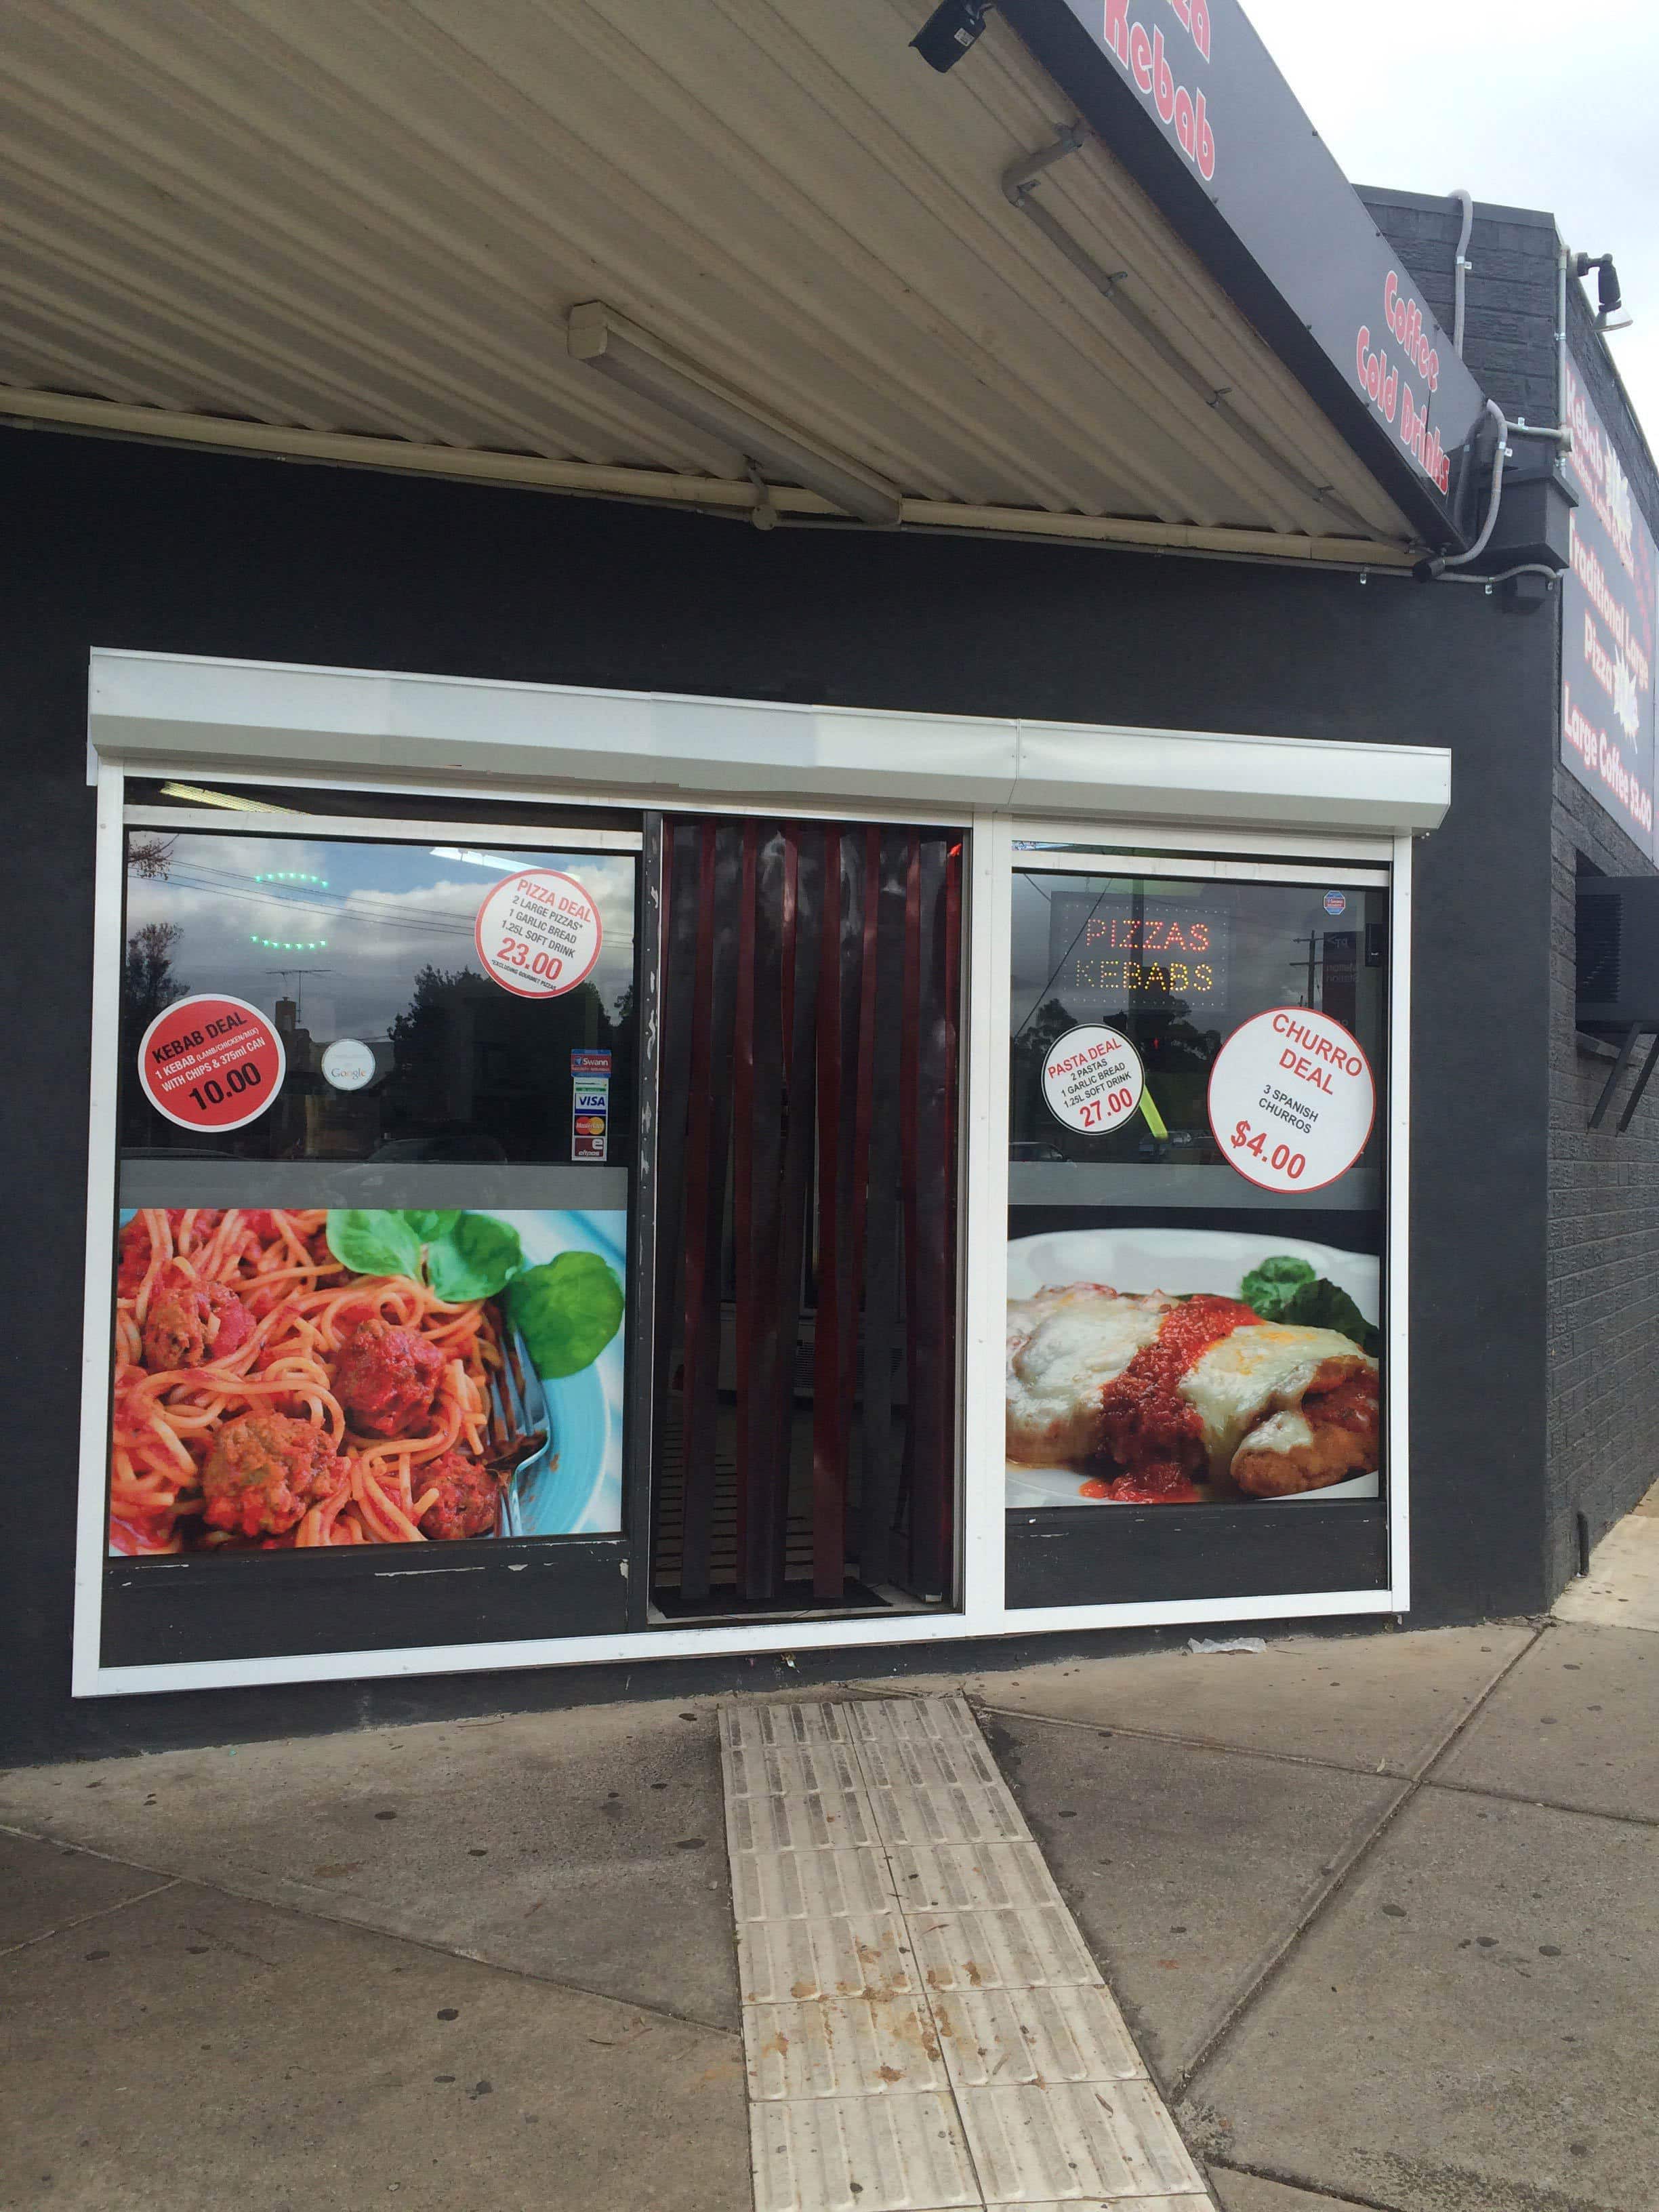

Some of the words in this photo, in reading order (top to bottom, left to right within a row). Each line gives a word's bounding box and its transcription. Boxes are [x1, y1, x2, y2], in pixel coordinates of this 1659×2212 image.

[1104, 0, 1215, 181] Kebab
[1385, 270, 1439, 392] Coffee
[1357, 325, 1398, 423] Cold
[1400, 382, 1450, 495] Drinks
[1564, 681, 1598, 769] Large
[1599, 729, 1629, 808] Coffee
[512, 895, 520, 905] 2
[520, 898, 549, 917] LARGE
[517, 879, 555, 906] PIZZA
[558, 897, 592, 922] DEAL
[501, 920, 523, 937] 1.25L
[525, 930, 548, 946] SOFT
[548, 939, 575, 958] DRINK
[510, 909, 514, 917] 1
[516, 911, 548, 931] GARLIC
[548, 925, 577, 944] BREAD
[1086, 918, 1210, 951] PIZZAS
[497, 937, 562, 980] 23.00
[1076, 960, 1212, 991] KEBABS
[151, 1030, 205, 1064] KEBAB
[205, 1012, 247, 1039] DEAL
[1272, 1012, 1362, 1077] CHURRO
[155, 1070, 162, 1080] 1
[163, 1054, 196, 1076] KEBAB
[161, 1075, 186, 1092] WITH
[186, 1062, 212, 1081] CHIPS
[212, 1059, 220, 1069] &
[220, 1046, 247, 1065] 375ml
[246, 1037, 266, 1052] CAN
[583, 1057, 608, 1066] Swann
[1048, 1053, 1088, 1079] PASTA
[1088, 1038, 1122, 1060] DEAL
[1071, 1072, 1077, 1081] 2
[1077, 1059, 1107, 1078] PASTAS
[1279, 1048, 1334, 1095] DEAL
[188, 1062, 262, 1111] 10.00
[1061, 1089, 1067, 1097] 1
[1067, 1075, 1097, 1094] GARLIC
[1097, 1062, 1125, 1080] BREAD
[1063, 1094, 1084, 1108] 1.25L
[1084, 1082, 1105, 1099] SOFT
[1106, 1071, 1132, 1088] DRINK
[579, 1096, 605, 1106] VISA
[1080, 1088, 1132, 1128] 27.00
[1258, 1098, 1311, 1134] CHURROS
[1263, 1084, 1271, 1094] 3
[1272, 1089, 1319, 1122] SPANISH
[1230, 1120, 1306, 1179] $4.00
